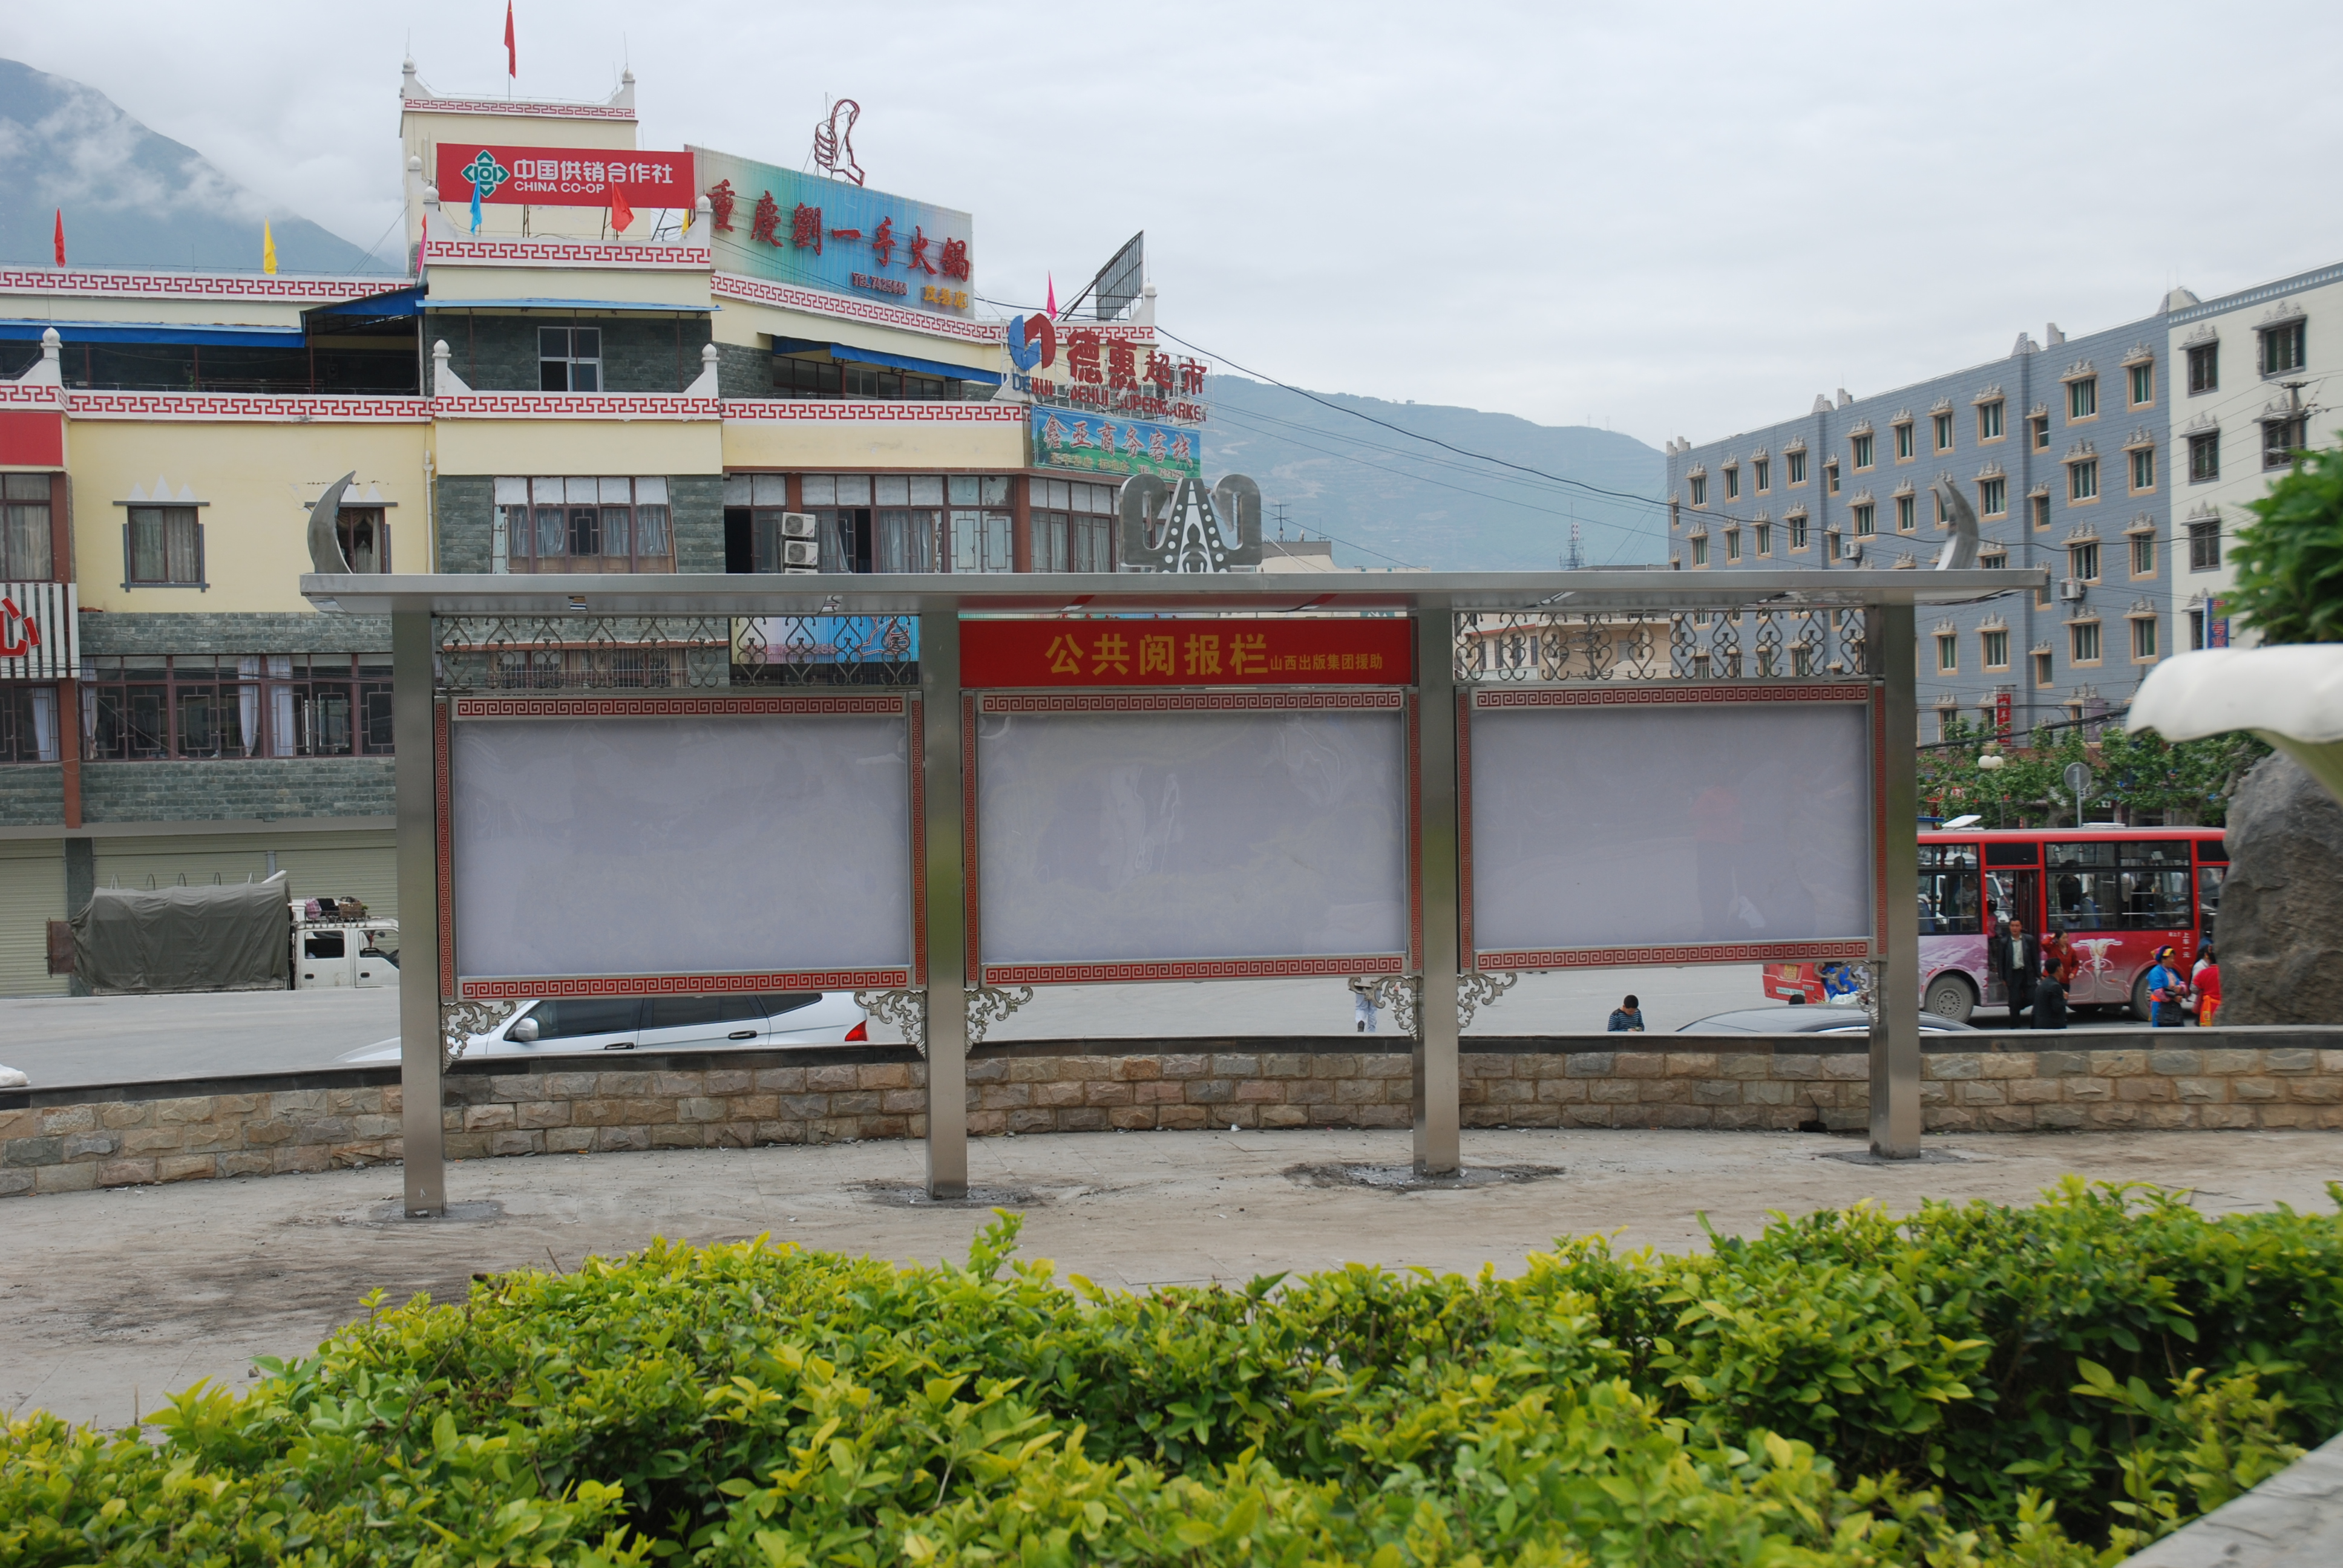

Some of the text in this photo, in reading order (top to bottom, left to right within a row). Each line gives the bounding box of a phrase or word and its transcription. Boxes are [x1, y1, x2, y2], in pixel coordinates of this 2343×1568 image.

[514, 158, 673, 184] 中国供销合作社
[514, 181, 605, 194] CHINA CO-OP
[1067, 329, 1207, 395] 德惠超市
[1012, 373, 1053, 397] DEHUI
[1070, 385, 1109, 407] DEHUI
[0, 596, 41, 658] 心
[1045, 634, 1383, 676] 公共阅报栏 山西出版集团援助
